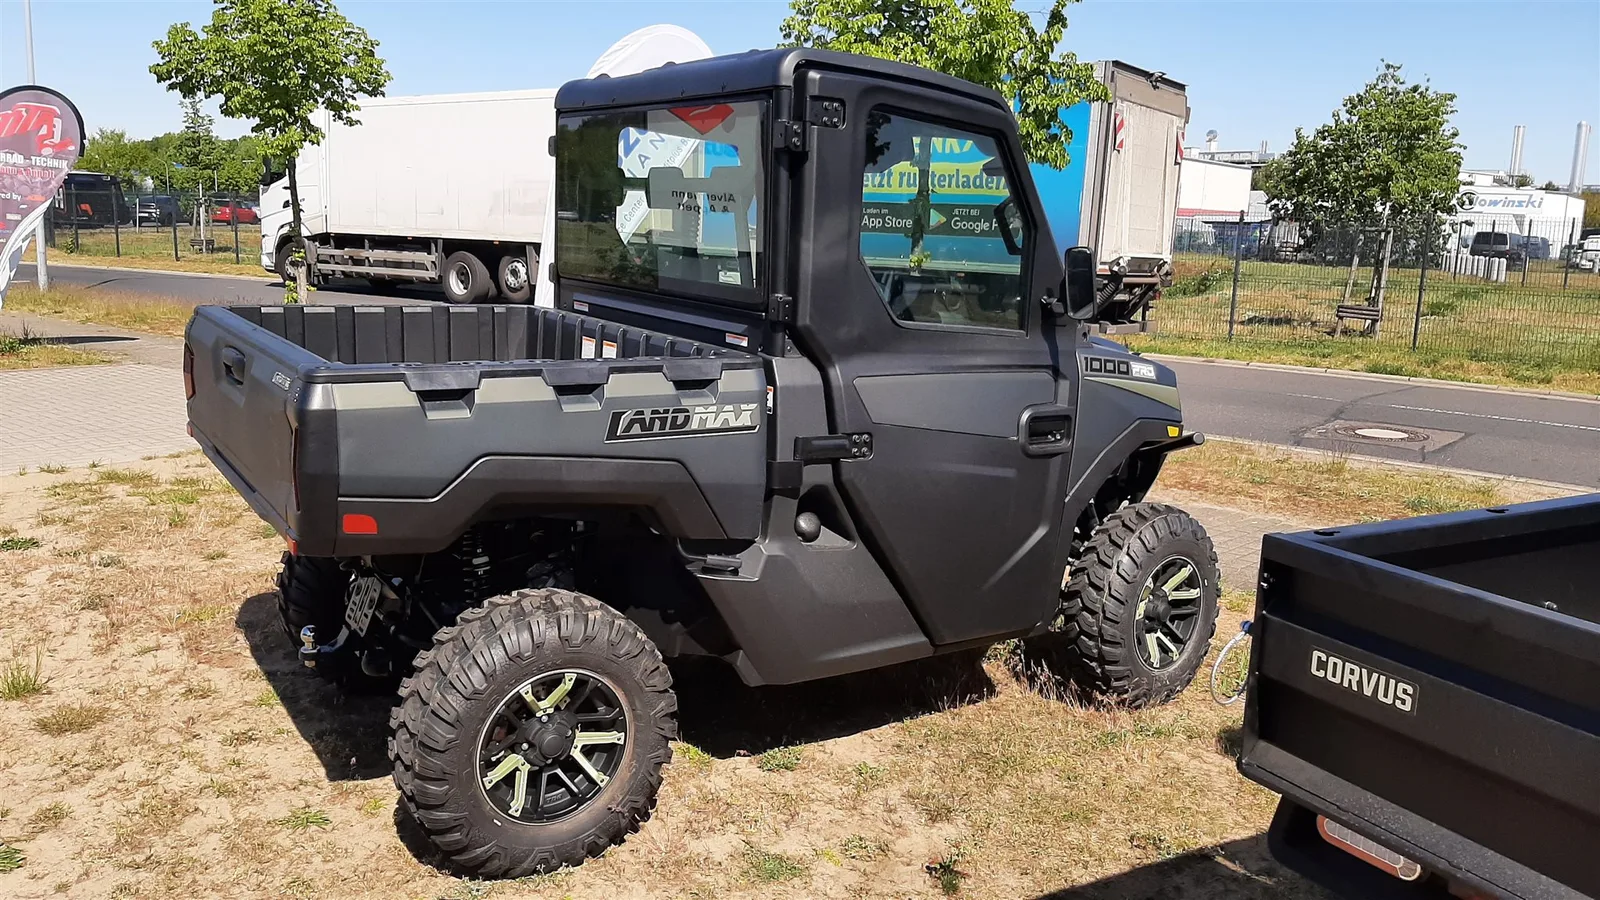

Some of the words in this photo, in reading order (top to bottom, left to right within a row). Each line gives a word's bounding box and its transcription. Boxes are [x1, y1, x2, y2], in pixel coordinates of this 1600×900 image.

[31, 156, 68, 170] TECHNIK
[863, 168, 894, 189] etzt
[898, 168, 1007, 190] ruterladen
[12, 192, 22, 202] by
[623, 196, 645, 222] Center
[861, 215, 883, 229] App
[884, 215, 913, 228] Store
[951, 217, 990, 233] Google
[1083, 356, 1130, 376] 1000
[605, 404, 760, 443] LANDMAX
[1310, 650, 1414, 711] CORVUS
